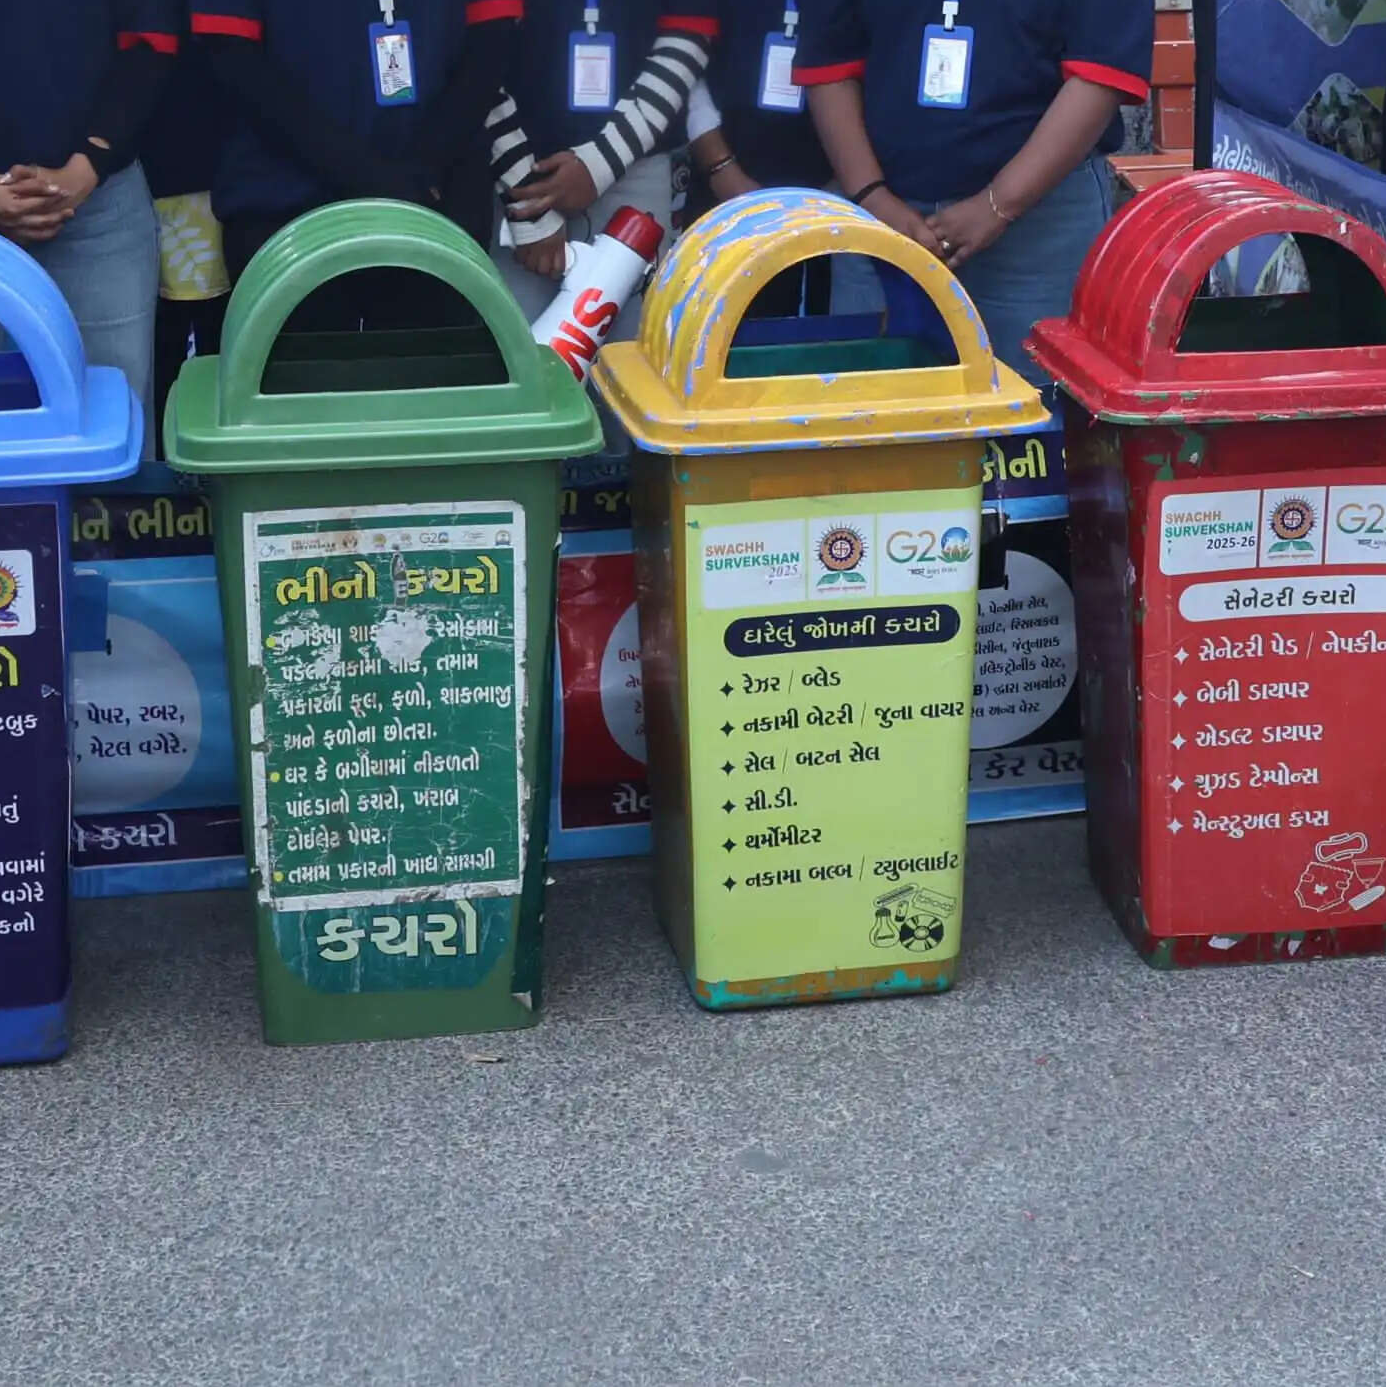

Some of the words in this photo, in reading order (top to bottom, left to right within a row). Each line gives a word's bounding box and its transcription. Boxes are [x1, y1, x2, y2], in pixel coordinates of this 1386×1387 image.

[1165, 510, 1221, 525] SWACHH
[1165, 521, 1254, 539] SURVEKSHAN
[705, 541, 764, 557] SWACHH
[886, 527, 973, 564] G20
[1206, 535, 1256, 551] 2025-26
[705, 552, 800, 572] SURVEKSHAN
[768, 564, 798, 579] 2025
[276, 560, 376, 605] ભીનો
[1223, 586, 1293, 612] સેનેટરી
[1302, 583, 1356, 607] કચરો
[743, 618, 797, 647] ઘરેલું
[803, 614, 877, 640] જોખમી
[885, 610, 941, 635] કચરો
[1198, 635, 1263, 663] સેનેટરી
[1270, 632, 1299, 656] પેડ
[436, 653, 479, 672] તમામ
[742, 673, 781, 695] રેઝર
[802, 666, 841, 688] બ્લેડ
[1196, 679, 1240, 704] બેબી
[1249, 680, 1310, 701] ડાયપર
[391, 682, 432, 711] ફળો,
[440, 685, 512, 708] શાકભાજી
[87, 702, 131, 726] પેપર,
[138, 703, 186, 725] રબર,
[743, 708, 799, 734] નકામી
[807, 703, 854, 728] બેટરી
[874, 704, 913, 730] જુના
[921, 701, 964, 719] વાયર
[89, 735, 131, 759] મેટલ
[138, 732, 187, 756] વગેરે.
[323, 720, 376, 751] ફળોના
[1195, 724, 1254, 747] એડલ્ટ
[1262, 723, 1324, 743] ડાયપર
[284, 767, 308, 784] ઘર
[315, 756, 328, 781] કે
[413, 746, 481, 774] નીકળતો
[744, 750, 776, 773] સેલ
[796, 749, 841, 767] બટન
[849, 742, 880, 763] સેલ
[356, 785, 405, 813] કચરો,
[413, 787, 459, 808] ખરાબ
[744, 786, 798, 813] સી.ડી.
[1288, 809, 1330, 829] કપ્સ
[744, 824, 822, 850] થર્મોમીટર
[288, 864, 331, 884] તમામ
[338, 855, 397, 881] પ્રકારની
[745, 865, 802, 889] નકામા
[808, 863, 853, 882] બલ્બ
[2, 881, 45, 904] વગેરે
[316, 897, 478, 963] કચરો
